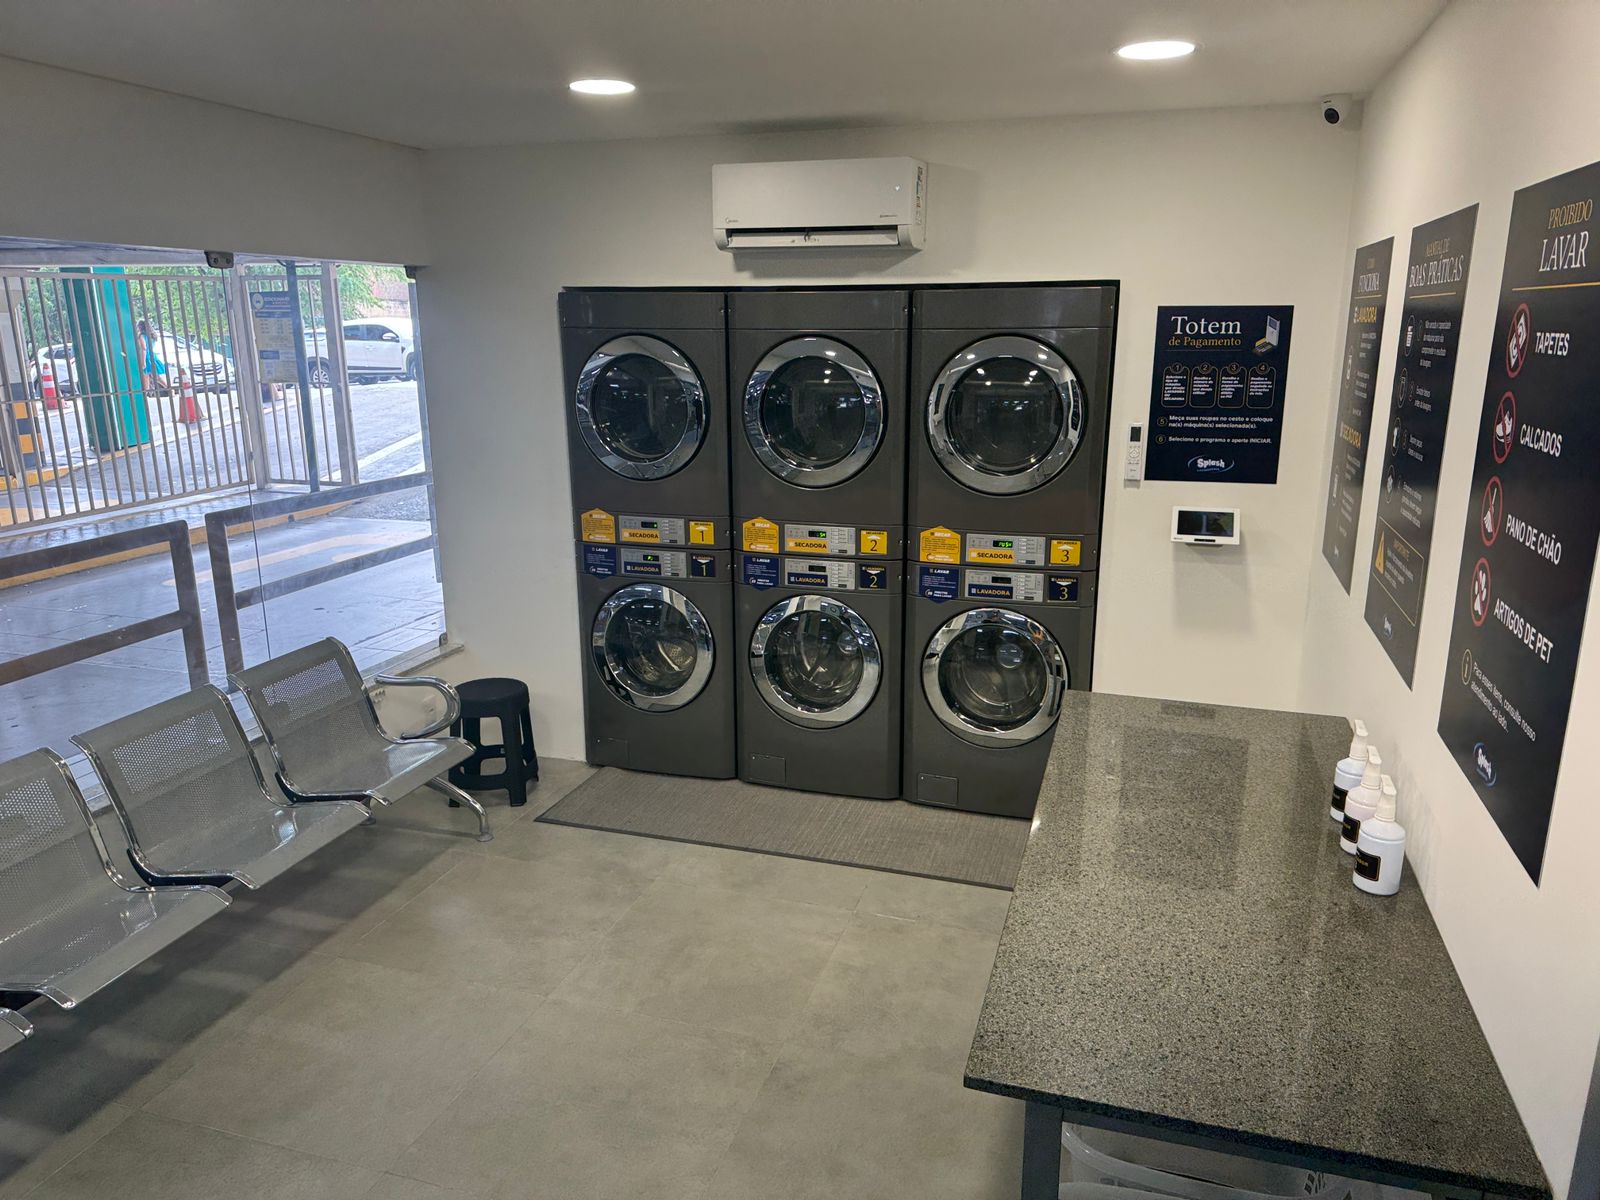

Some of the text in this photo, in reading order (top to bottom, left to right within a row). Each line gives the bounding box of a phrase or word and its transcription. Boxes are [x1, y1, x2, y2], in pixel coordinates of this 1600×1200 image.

[1548, 199, 1593, 229] PROIBIDO
[1539, 230, 1589, 272] LAVAR
[1409, 263, 1427, 288] BOAS
[1427, 254, 1464, 285] PRÁTICAS
[1171, 316, 1241, 334] Totem
[1168, 337, 1241, 348] de Pagamento
[1535, 331, 1570, 356] TAPETES
[1197, 458, 1225, 468] Splash
[870, 539, 878, 551] 2
[1505, 513, 1562, 565] PANO DE CHÃO
[977, 552, 1013, 560] SECADORA
[1060, 549, 1070, 562] 3
[700, 564, 706, 576] 1
[870, 575, 878, 588] 2
[976, 588, 1010, 596] LAVADORA
[1059, 586, 1069, 600] 3
[1493, 597, 1554, 663] ARTIGOS DE PET
[1471, 681, 1492, 712] atendimento
[1473, 661, 1482, 680] Para
[1481, 674, 1493, 692] esses
[1503, 699, 1521, 726] consulte
[1520, 719, 1536, 741] nosso
